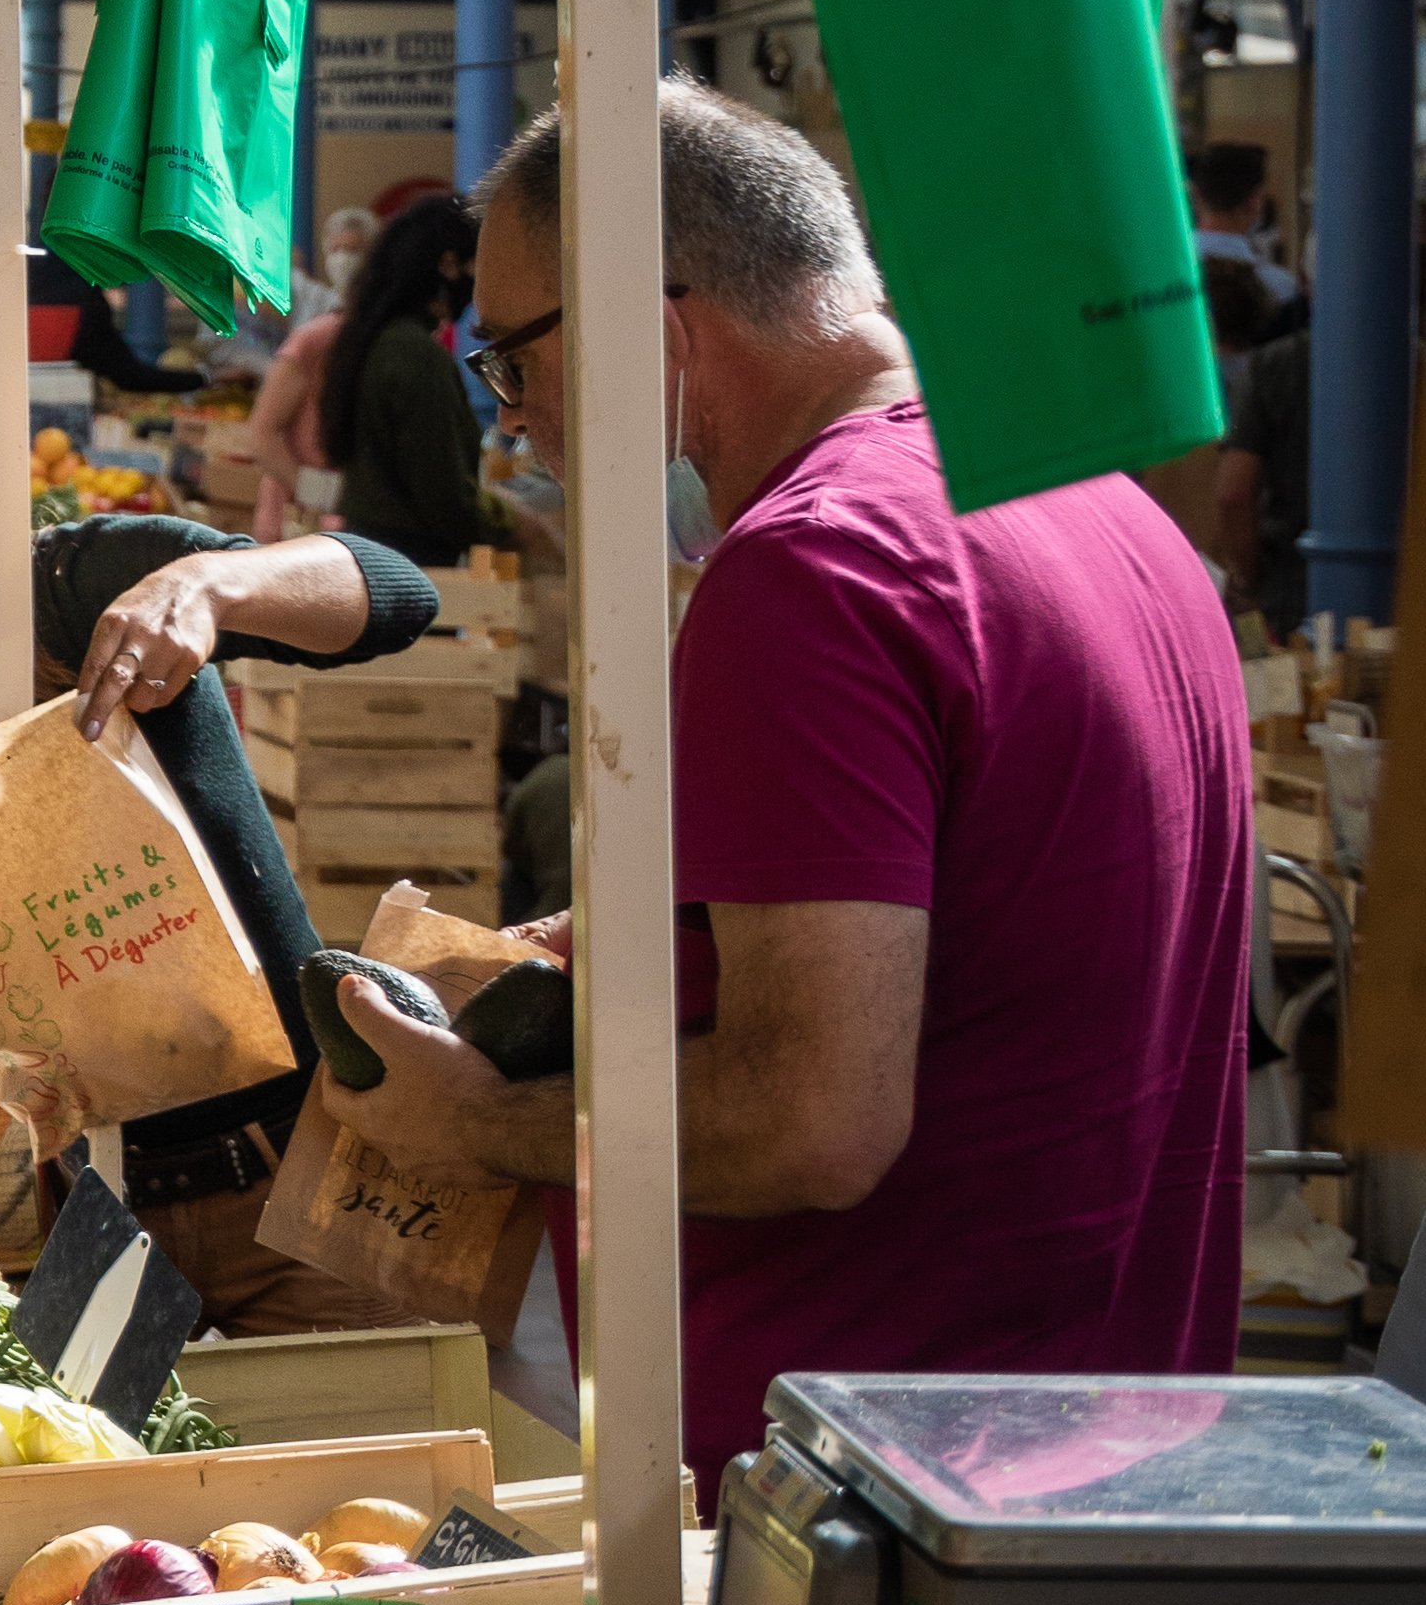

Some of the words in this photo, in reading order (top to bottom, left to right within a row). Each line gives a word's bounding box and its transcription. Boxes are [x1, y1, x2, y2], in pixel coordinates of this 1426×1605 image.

[92, 151, 109, 166] Ne
[22, 862, 125, 921] Fruits
[141, 844, 166, 867] &
[36, 874, 177, 952] Légumes
[81, 908, 197, 973] Déguster
